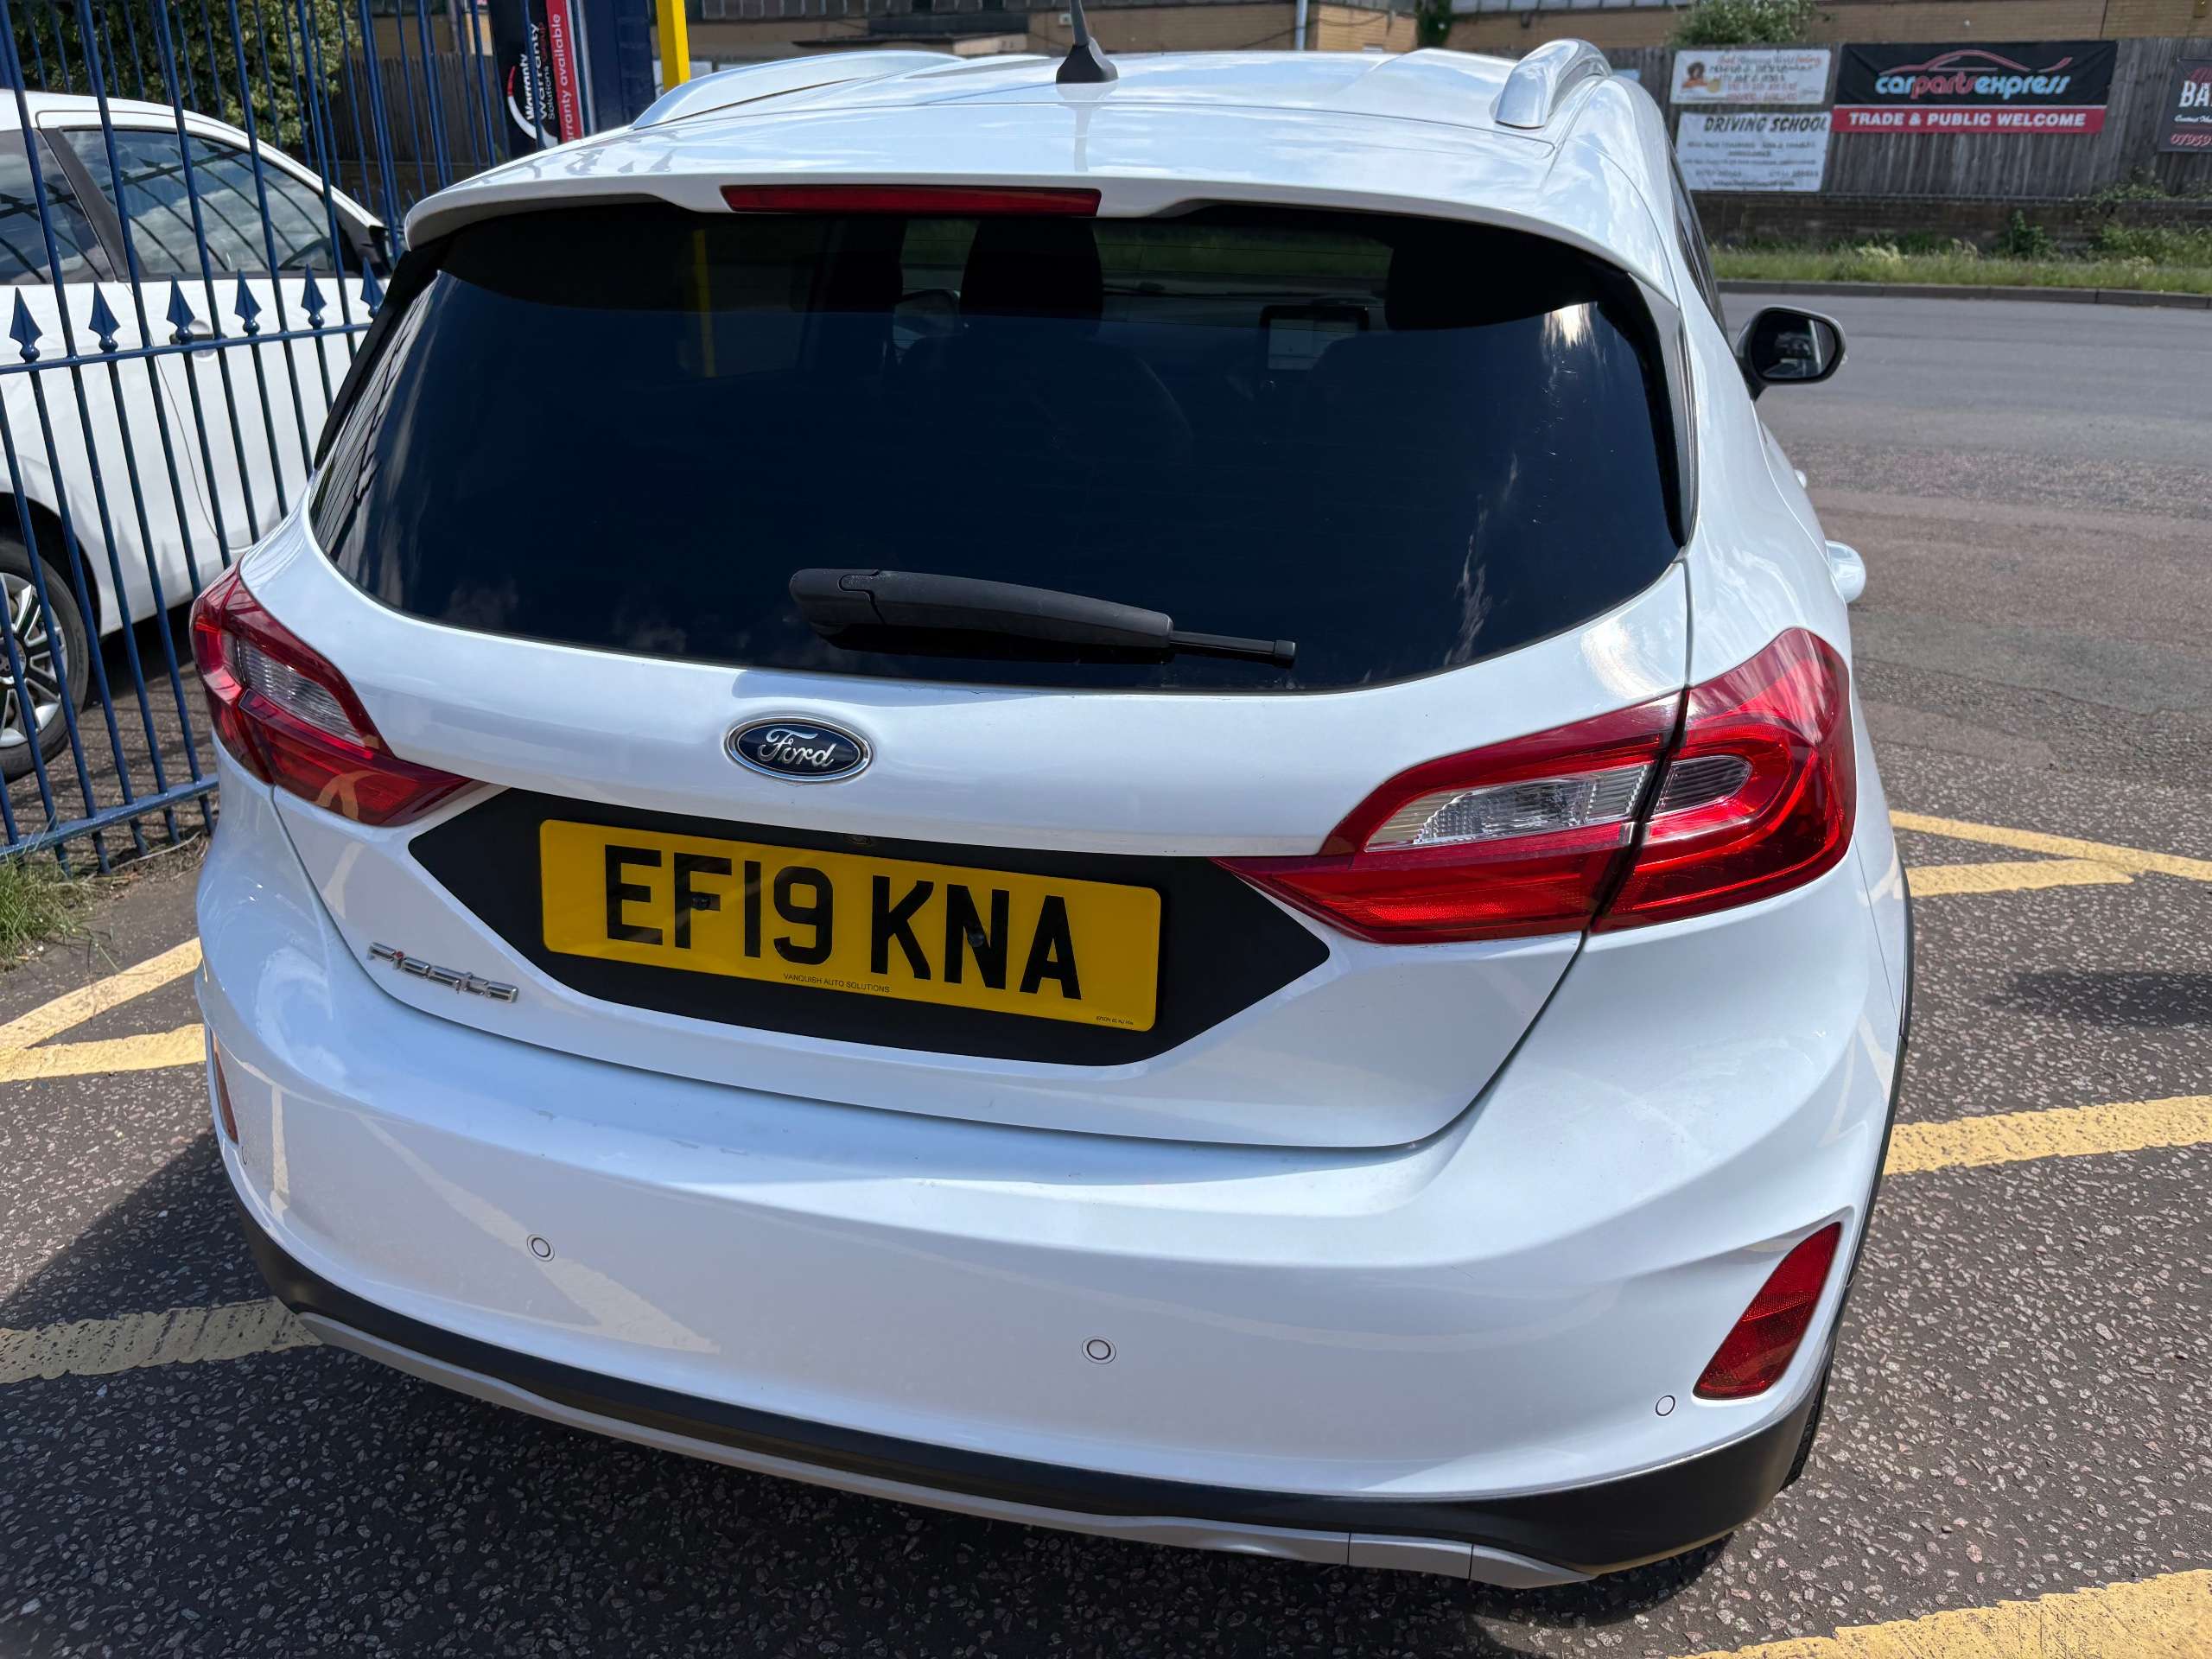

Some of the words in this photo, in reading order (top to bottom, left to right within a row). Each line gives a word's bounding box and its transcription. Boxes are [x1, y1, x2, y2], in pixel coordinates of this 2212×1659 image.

[530, 23, 547, 119] Warranty
[551, 14, 568, 86] available
[543, 66, 555, 120] Solutions
[561, 90, 575, 141] arranty
[1850, 112, 1904, 126] TRADE
[1908, 112, 1922, 126] &
[1927, 113, 1992, 126] PUBLIC
[1997, 112, 2086, 126] WELCOME
[1704, 117, 1768, 132] DRIVING
[1769, 116, 1827, 132] SCHOOL
[757, 728, 837, 768] Ford
[605, 844, 834, 965] EF19
[870, 874, 1082, 1000] KNA
[366, 942, 518, 1003] Fiesta
[784, 973, 822, 984] VANQUISH
[847, 981, 890, 993] SOLUTIONS
